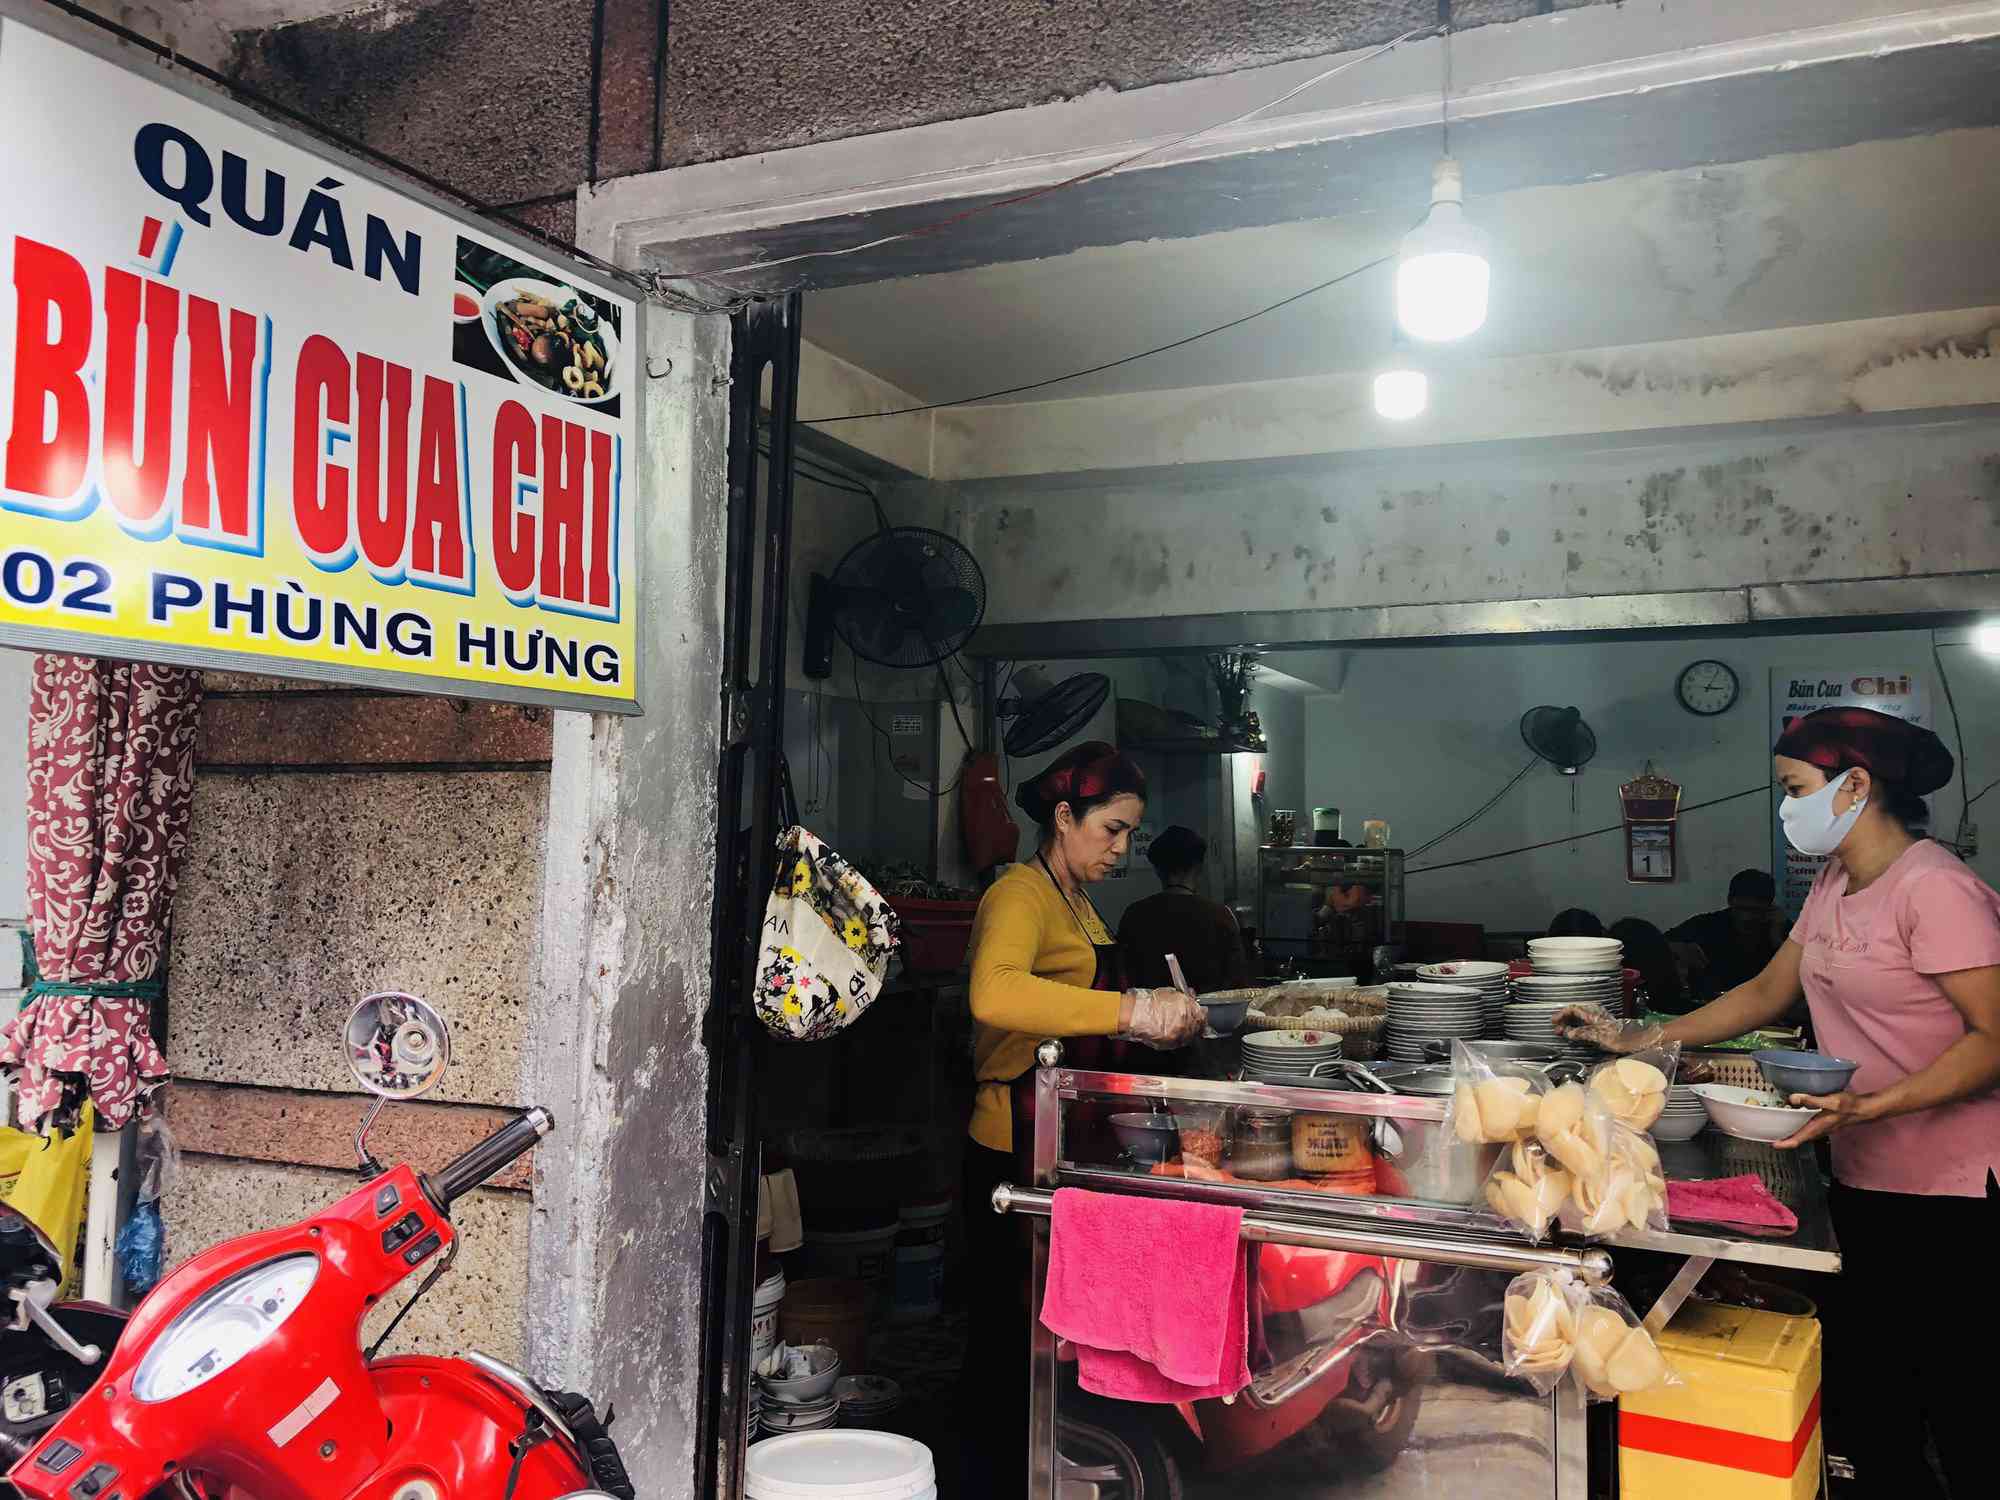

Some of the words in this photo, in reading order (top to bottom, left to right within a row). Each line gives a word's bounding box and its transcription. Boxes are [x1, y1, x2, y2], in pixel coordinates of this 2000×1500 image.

[134, 122, 421, 297] QUÁN
[4, 215, 271, 556] BÚN
[292, 334, 475, 597] CUA
[492, 400, 621, 624] CHI
[2, 551, 112, 614] 02
[152, 572, 433, 657] PHÙNG
[459, 621, 621, 683] HƯNG
[1851, 674, 1912, 696] Chi
